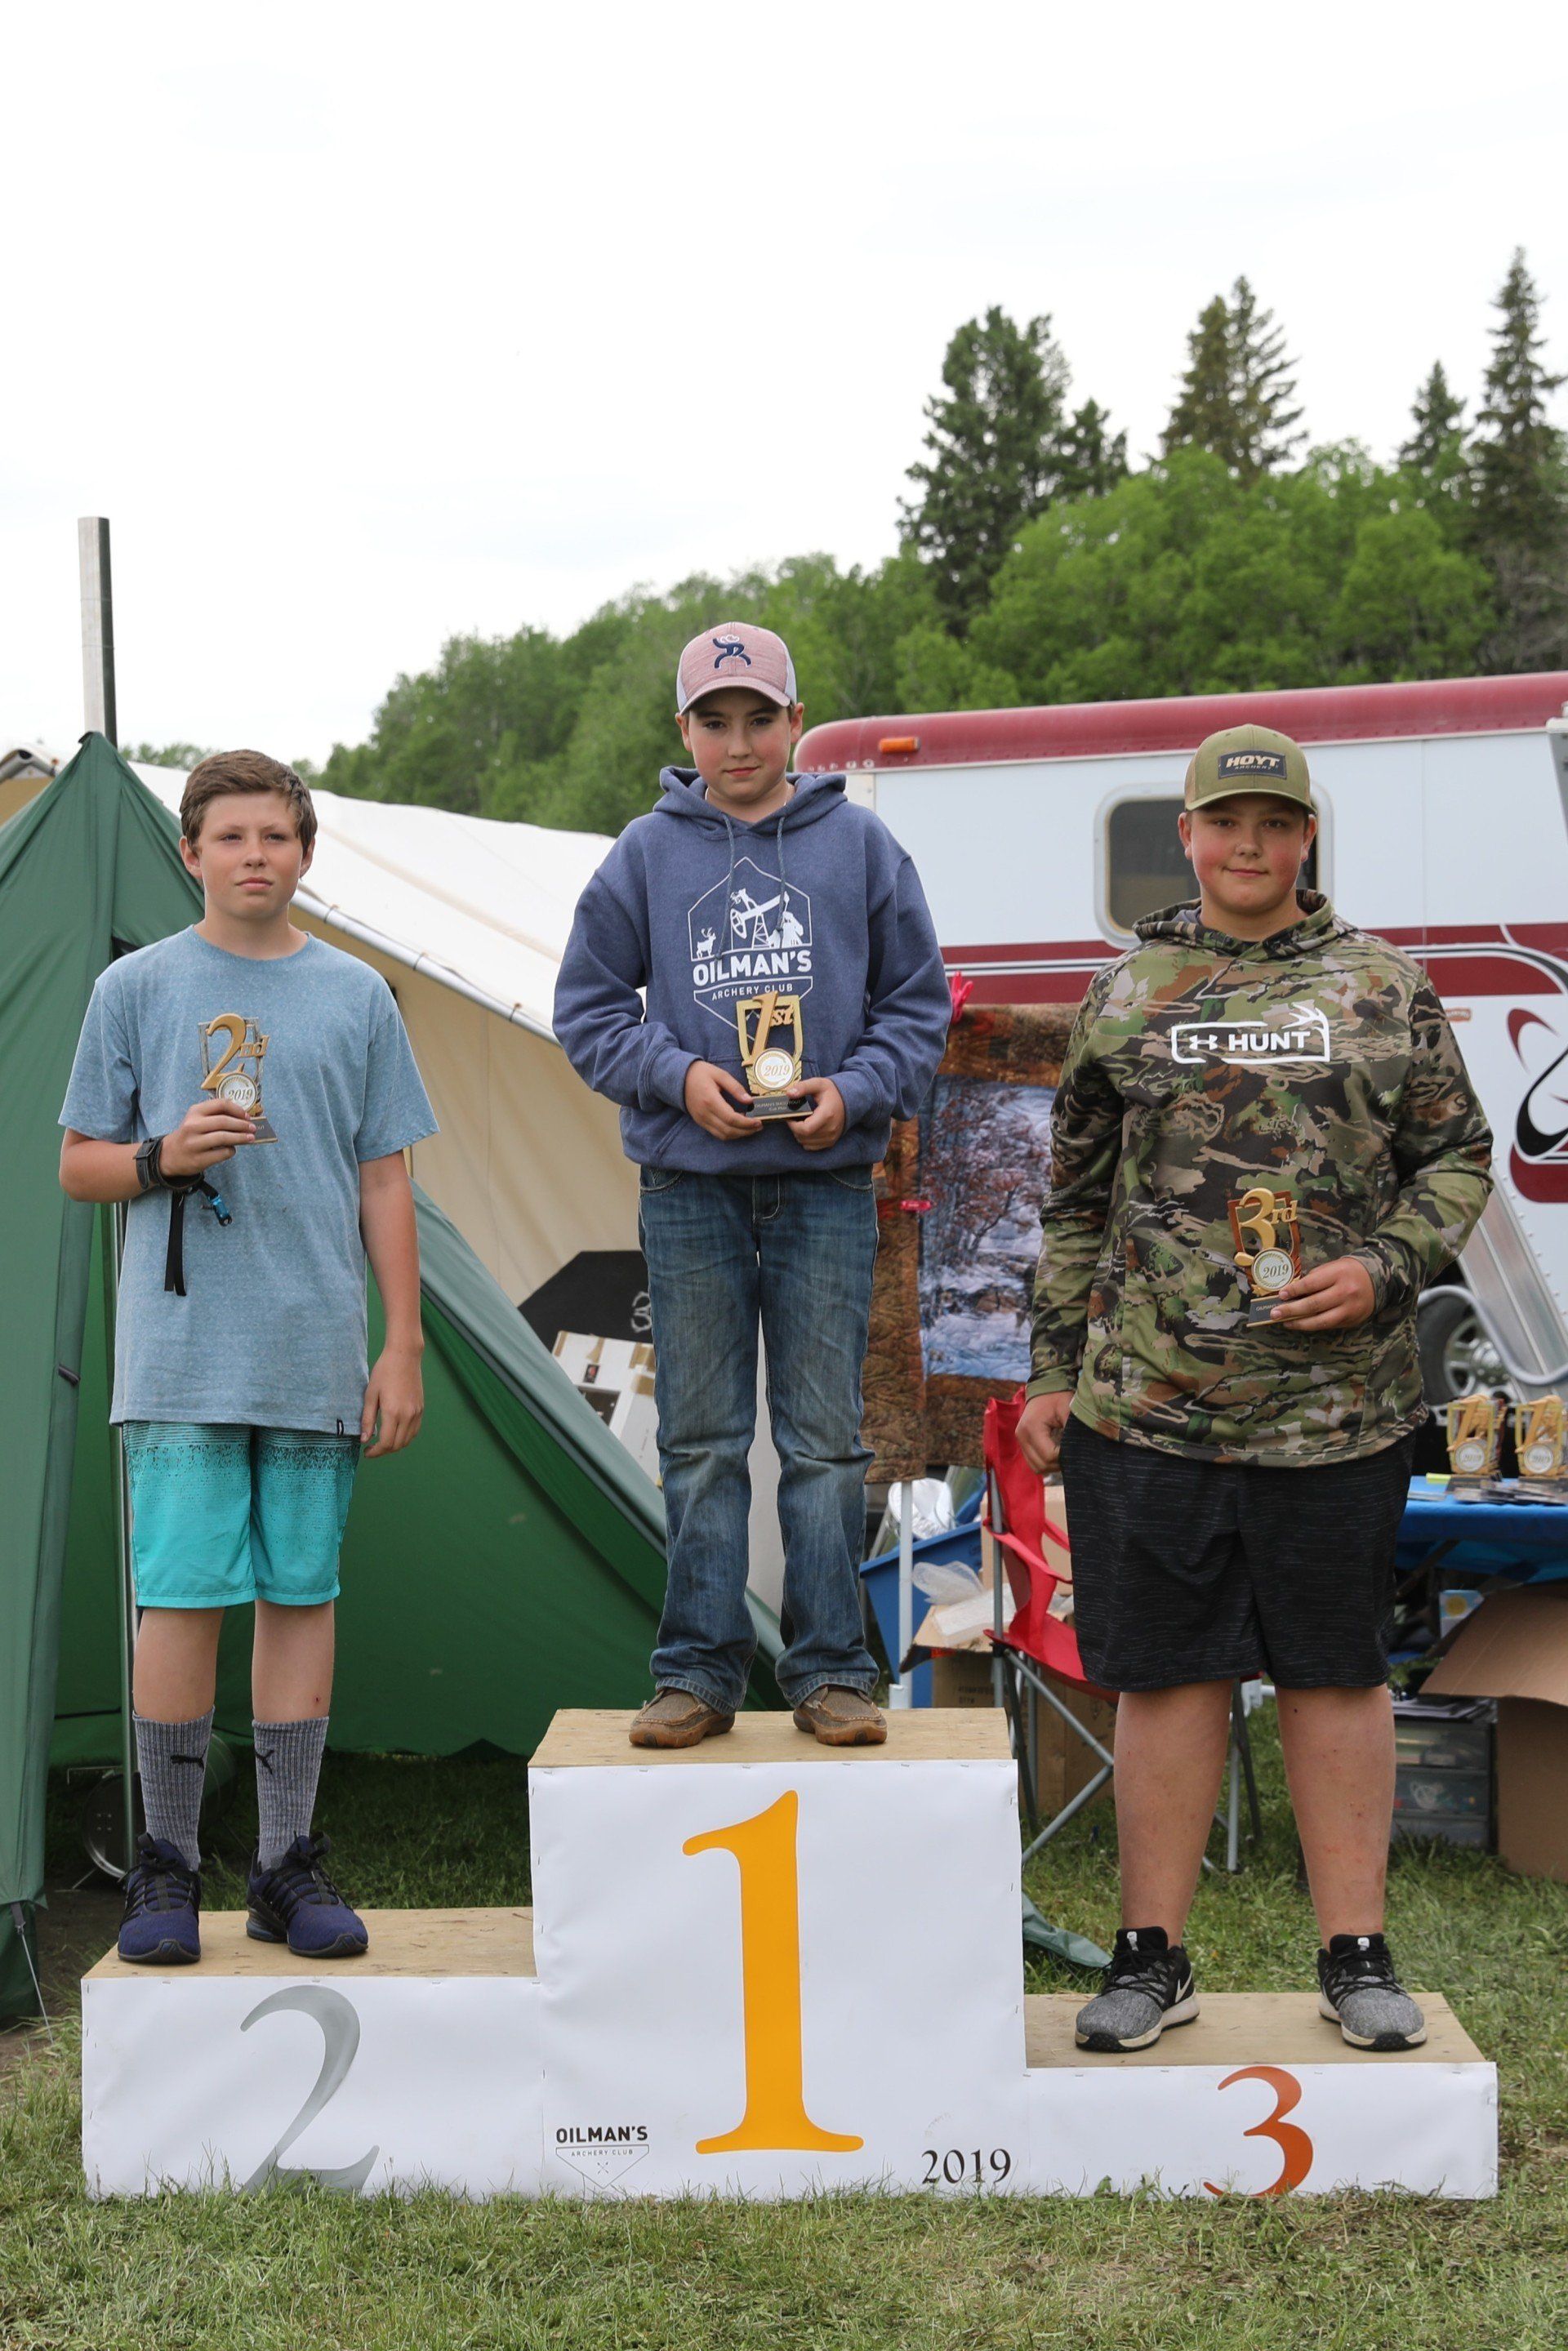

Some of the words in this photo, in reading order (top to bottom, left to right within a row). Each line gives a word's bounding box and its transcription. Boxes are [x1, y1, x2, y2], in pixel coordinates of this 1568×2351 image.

[1226, 755, 1280, 768] HOYT
[693, 950, 812, 986] OILMAN'S
[711, 985, 760, 1000] ARCHERY
[764, 983, 793, 993] CLUB
[202, 1013, 270, 1089] 2nd
[1228, 1031, 1311, 1052] HUNT
[763, 1064, 791, 1077] 2019
[227, 1088, 253, 1101] 2019
[1234, 1187, 1298, 1266] 3rd
[1262, 1264, 1290, 1279] 2019
[683, 1789, 864, 2154] 1
[240, 1984, 380, 2197] 2
[556, 2126, 648, 2144] OILMAN'S
[1203, 2066, 1313, 2197] 3
[921, 2148, 1011, 2184] 2019
